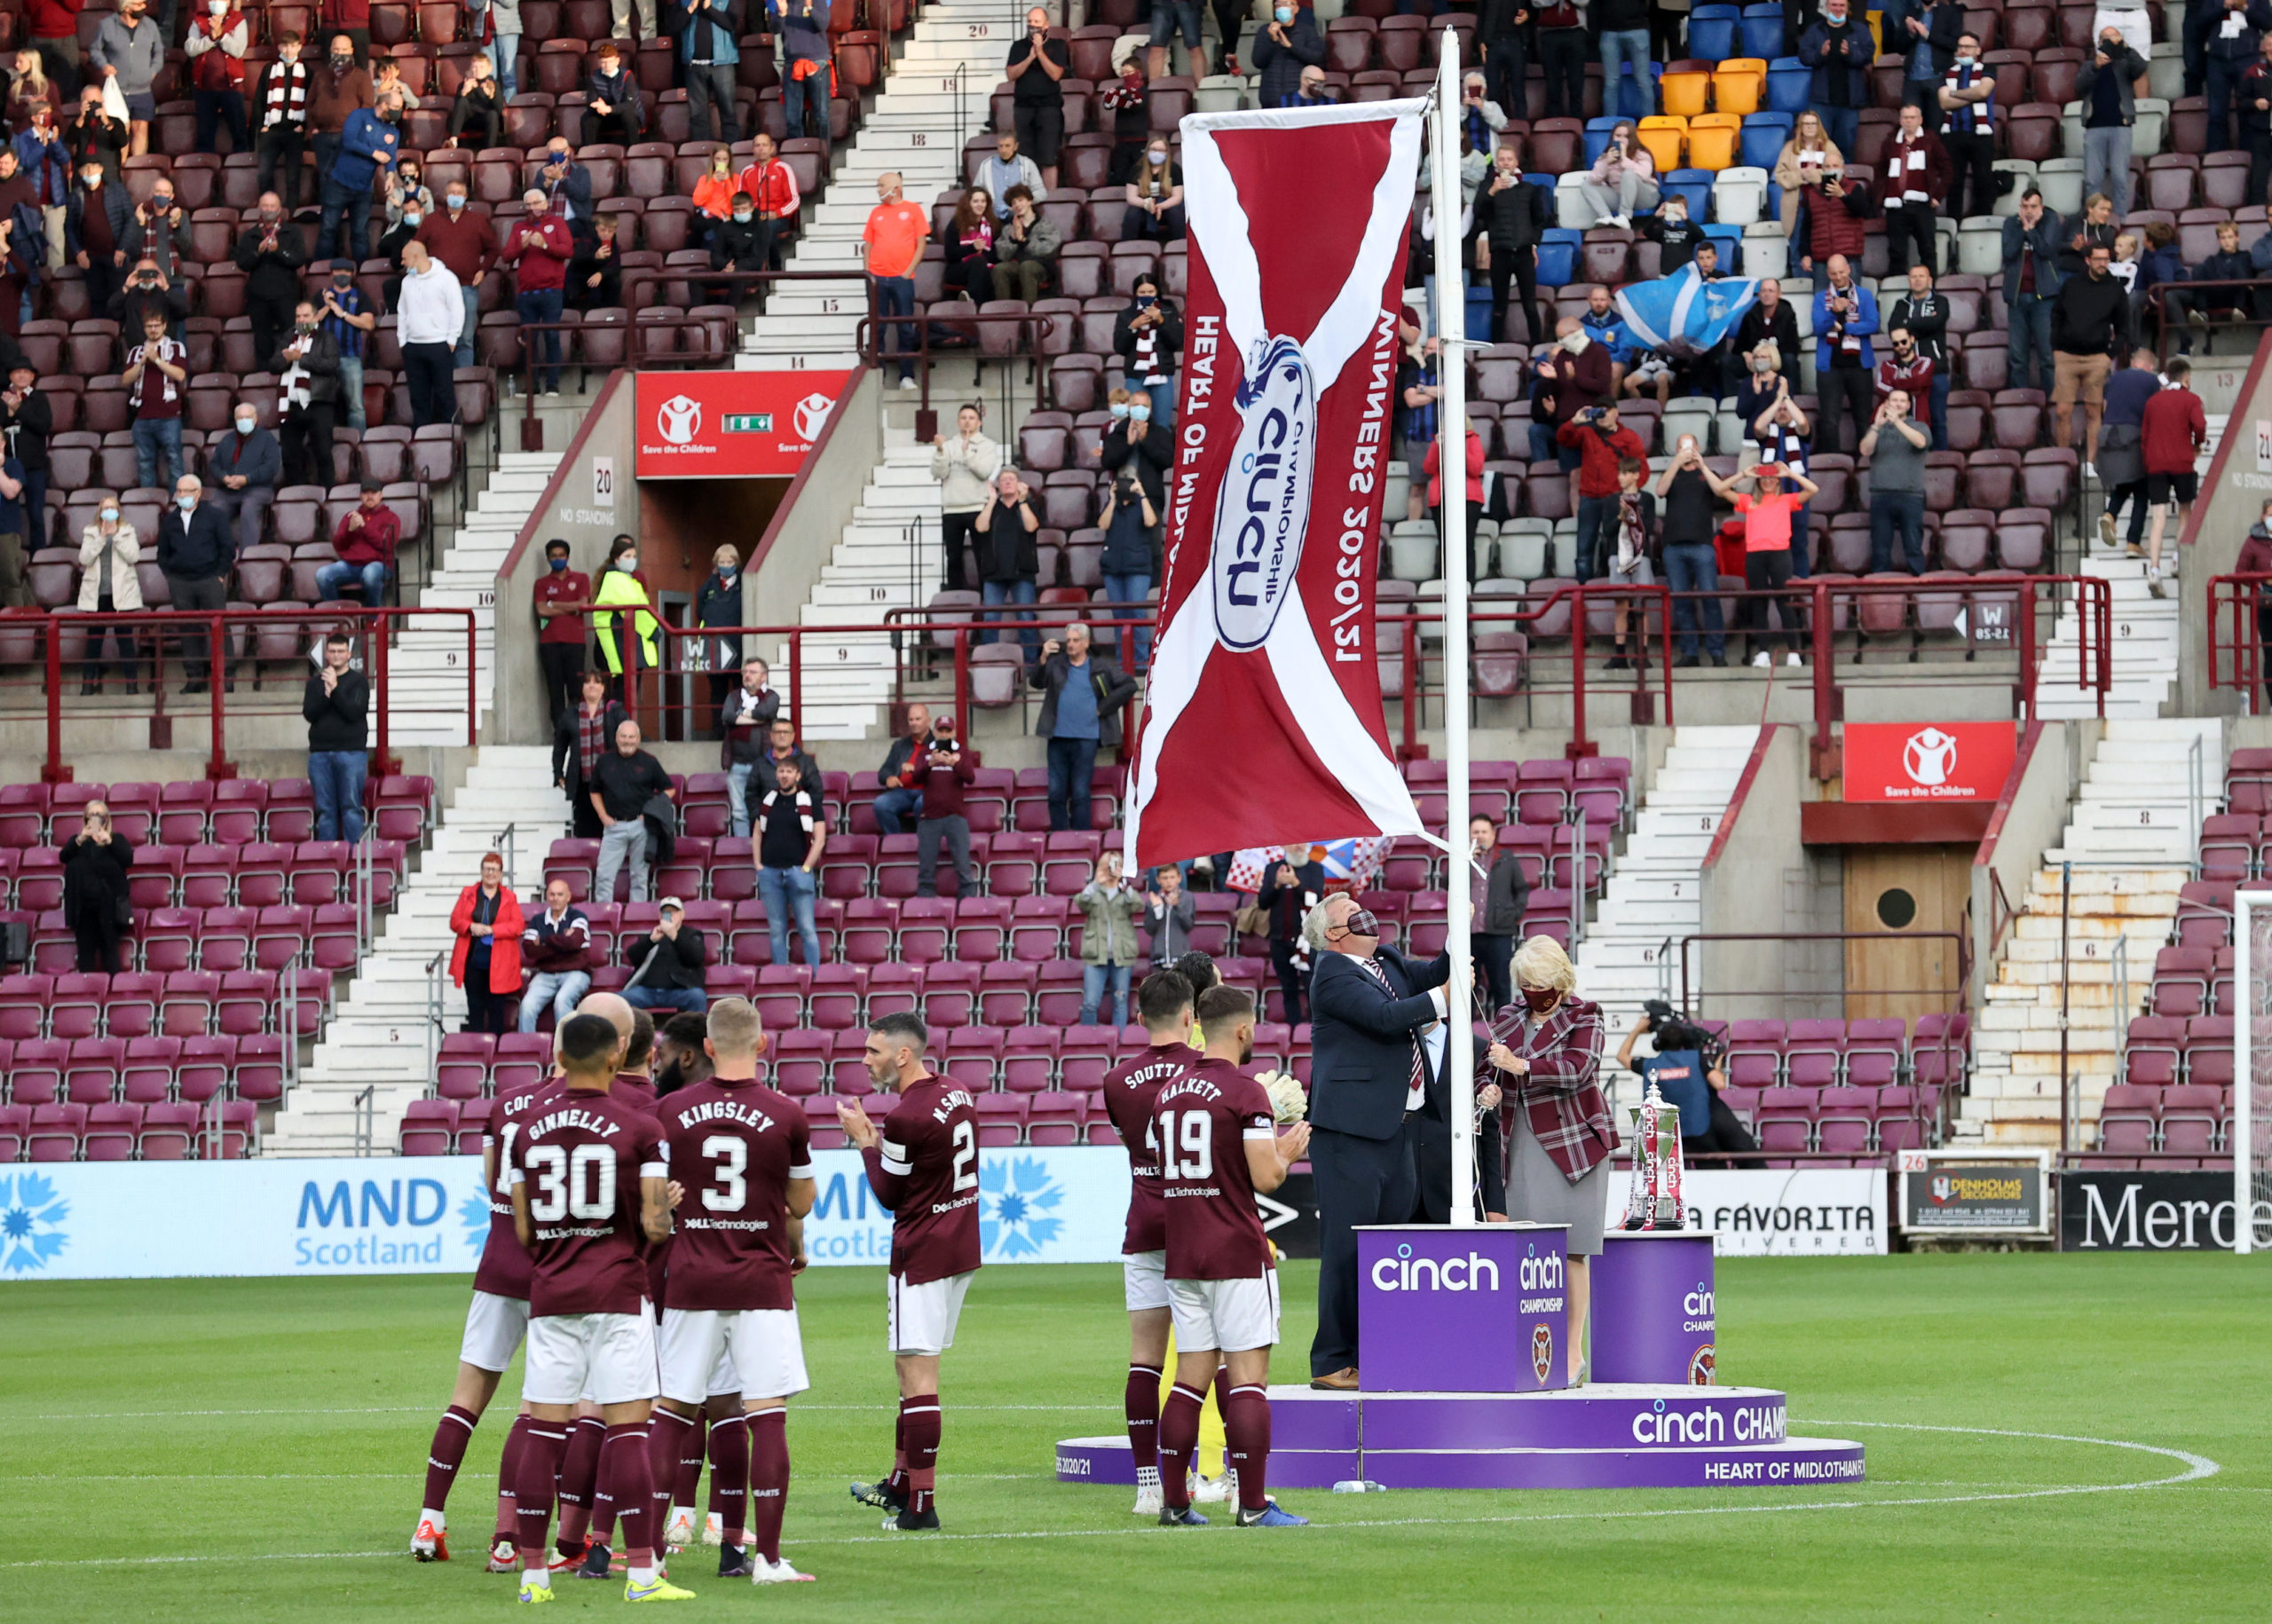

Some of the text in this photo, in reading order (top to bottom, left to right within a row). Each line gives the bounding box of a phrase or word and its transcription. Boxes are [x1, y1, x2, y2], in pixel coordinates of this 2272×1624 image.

[968, 24, 988, 37] 20
[911, 133, 926, 146] 18
[823, 299, 839, 312] 15
[643, 445, 716, 454] Save the Children
[778, 443, 798, 453] Save
[596, 469, 611, 493] 20
[560, 508, 615, 526] NO STANDING
[477, 593, 494, 606] 10
[870, 587, 887, 601] 10
[1982, 606, 2002, 625] W
[2120, 624, 2131, 637] 9
[686, 639, 706, 657] W
[838, 648, 848, 661] 9
[446, 652, 457, 666] 9
[1884, 785, 1976, 797] Save the Children
[1701, 817, 1711, 831] 8
[2140, 810, 2150, 824] 8
[1673, 883, 1681, 896] 7
[2110, 877, 2121, 890] 7
[1644, 950, 1653, 963] 6
[2086, 943, 2095, 957] 6
[1612, 1014, 1621, 1029] 5
[390, 1029, 399, 1042] 5
[1124, 1063, 1185, 1090] SOUTTA
[1161, 1078, 1222, 1104] HALKETT
[932, 1090, 974, 1124] M.SMITH
[528, 1108, 621, 1140] GINNELLY
[678, 1101, 775, 1133] KINGSLEY
[1646, 1107, 1656, 1139] cinch
[1159, 1109, 1213, 1179] 19
[951, 1120, 979, 1194] 2
[1904, 1155, 1926, 1171] 26
[701, 1135, 748, 1212] 3
[1646, 1151, 1657, 1184] cinch
[1668, 1156, 1679, 1189] cinch
[525, 1143, 618, 1222] 30
[1950, 1179, 2023, 1192] DENHOLMS
[296, 1179, 448, 1228] MND
[1960, 1191, 2022, 1200] DECORATORS
[1645, 1194, 1657, 1226] cinch
[1715, 1206, 1874, 1231] FAVORITA
[296, 1234, 442, 1266] Scotland
[1718, 1237, 1874, 1248] LIVERED
[1371, 1242, 1500, 1292] cinch
[1519, 1242, 1563, 1291] cinch
[1519, 1297, 1564, 1314] CHAMPIONSHIP
[1632, 1399, 1725, 1444] cinch
[1062, 1458, 1091, 1475] 2020/21
[1705, 1462, 1764, 1480] HEART
[1769, 1462, 1790, 1479] OF
[1794, 1459, 1858, 1479] MIDLOTHIAN
